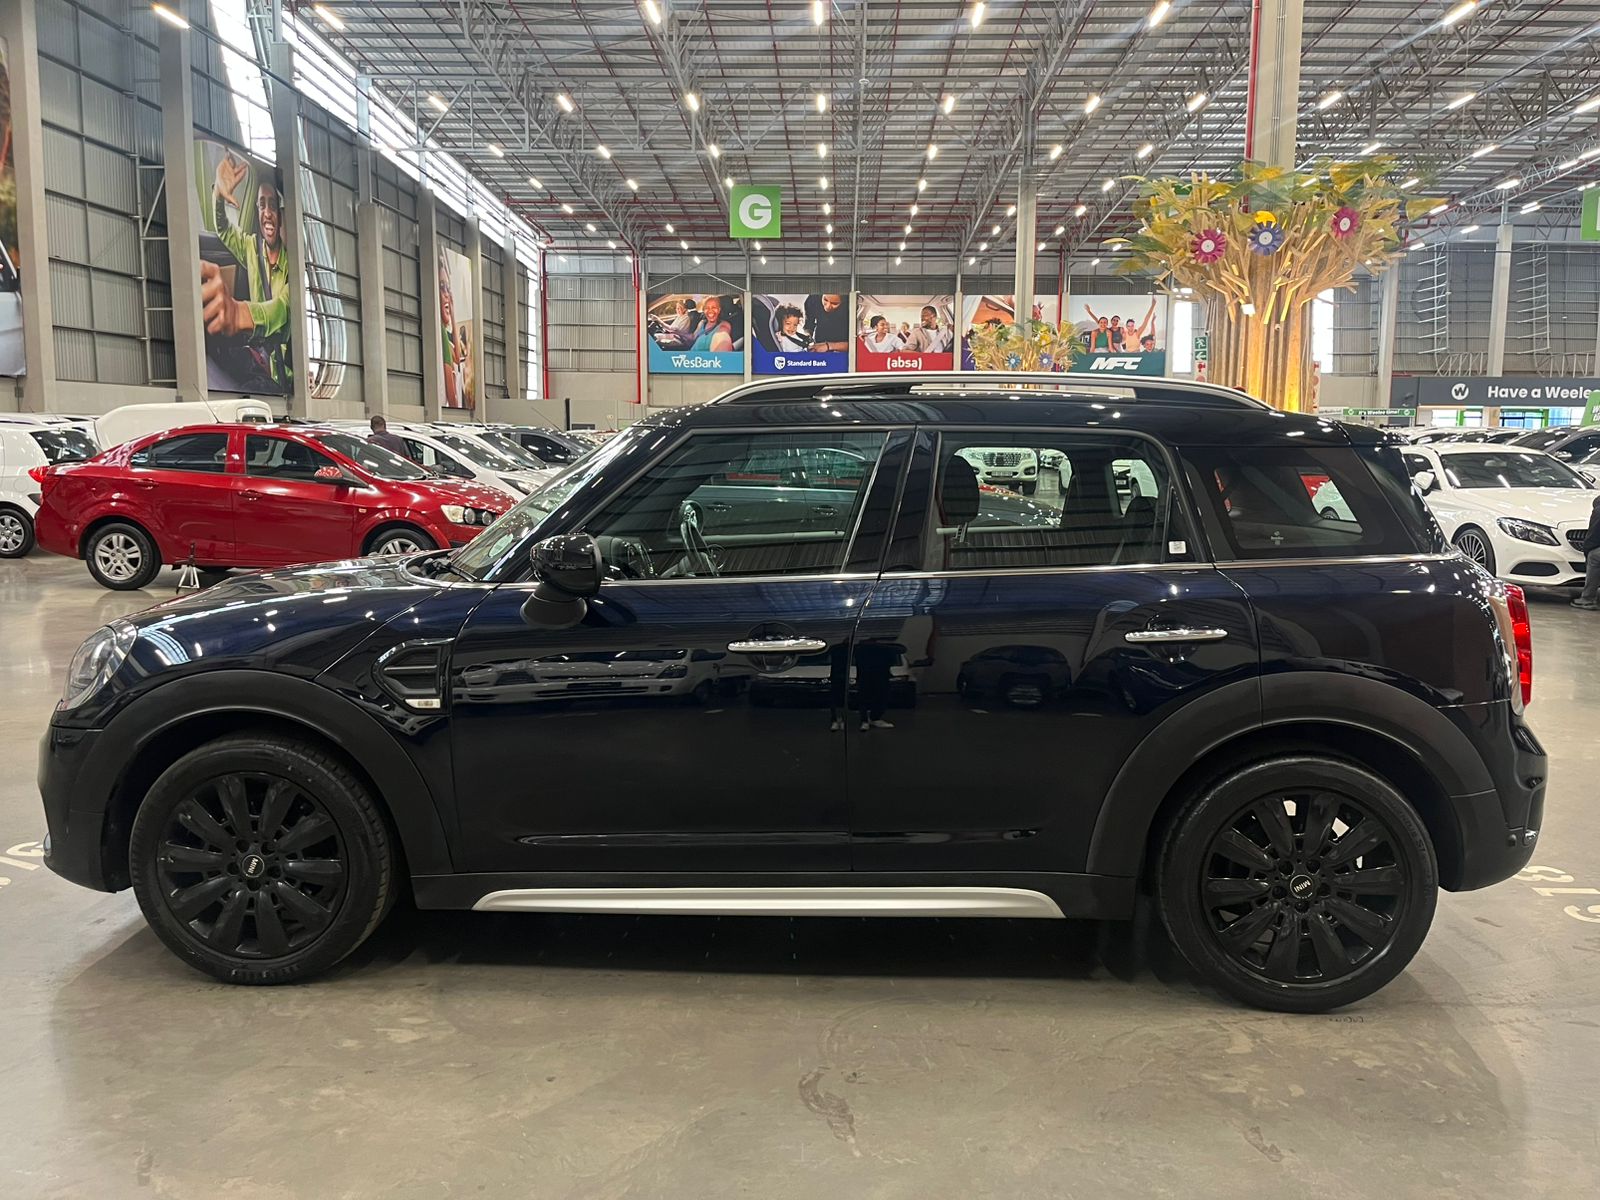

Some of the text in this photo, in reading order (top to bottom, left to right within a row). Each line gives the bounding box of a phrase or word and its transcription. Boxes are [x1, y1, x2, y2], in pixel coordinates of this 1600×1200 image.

[739, 193, 772, 230] G
[671, 355, 722, 369] WesBank
[886, 356, 923, 370] (absa)
[1089, 356, 1142, 370] MFC
[1487, 385, 1600, 399] Have a Weele
[1293, 879, 1311, 893] MINI
